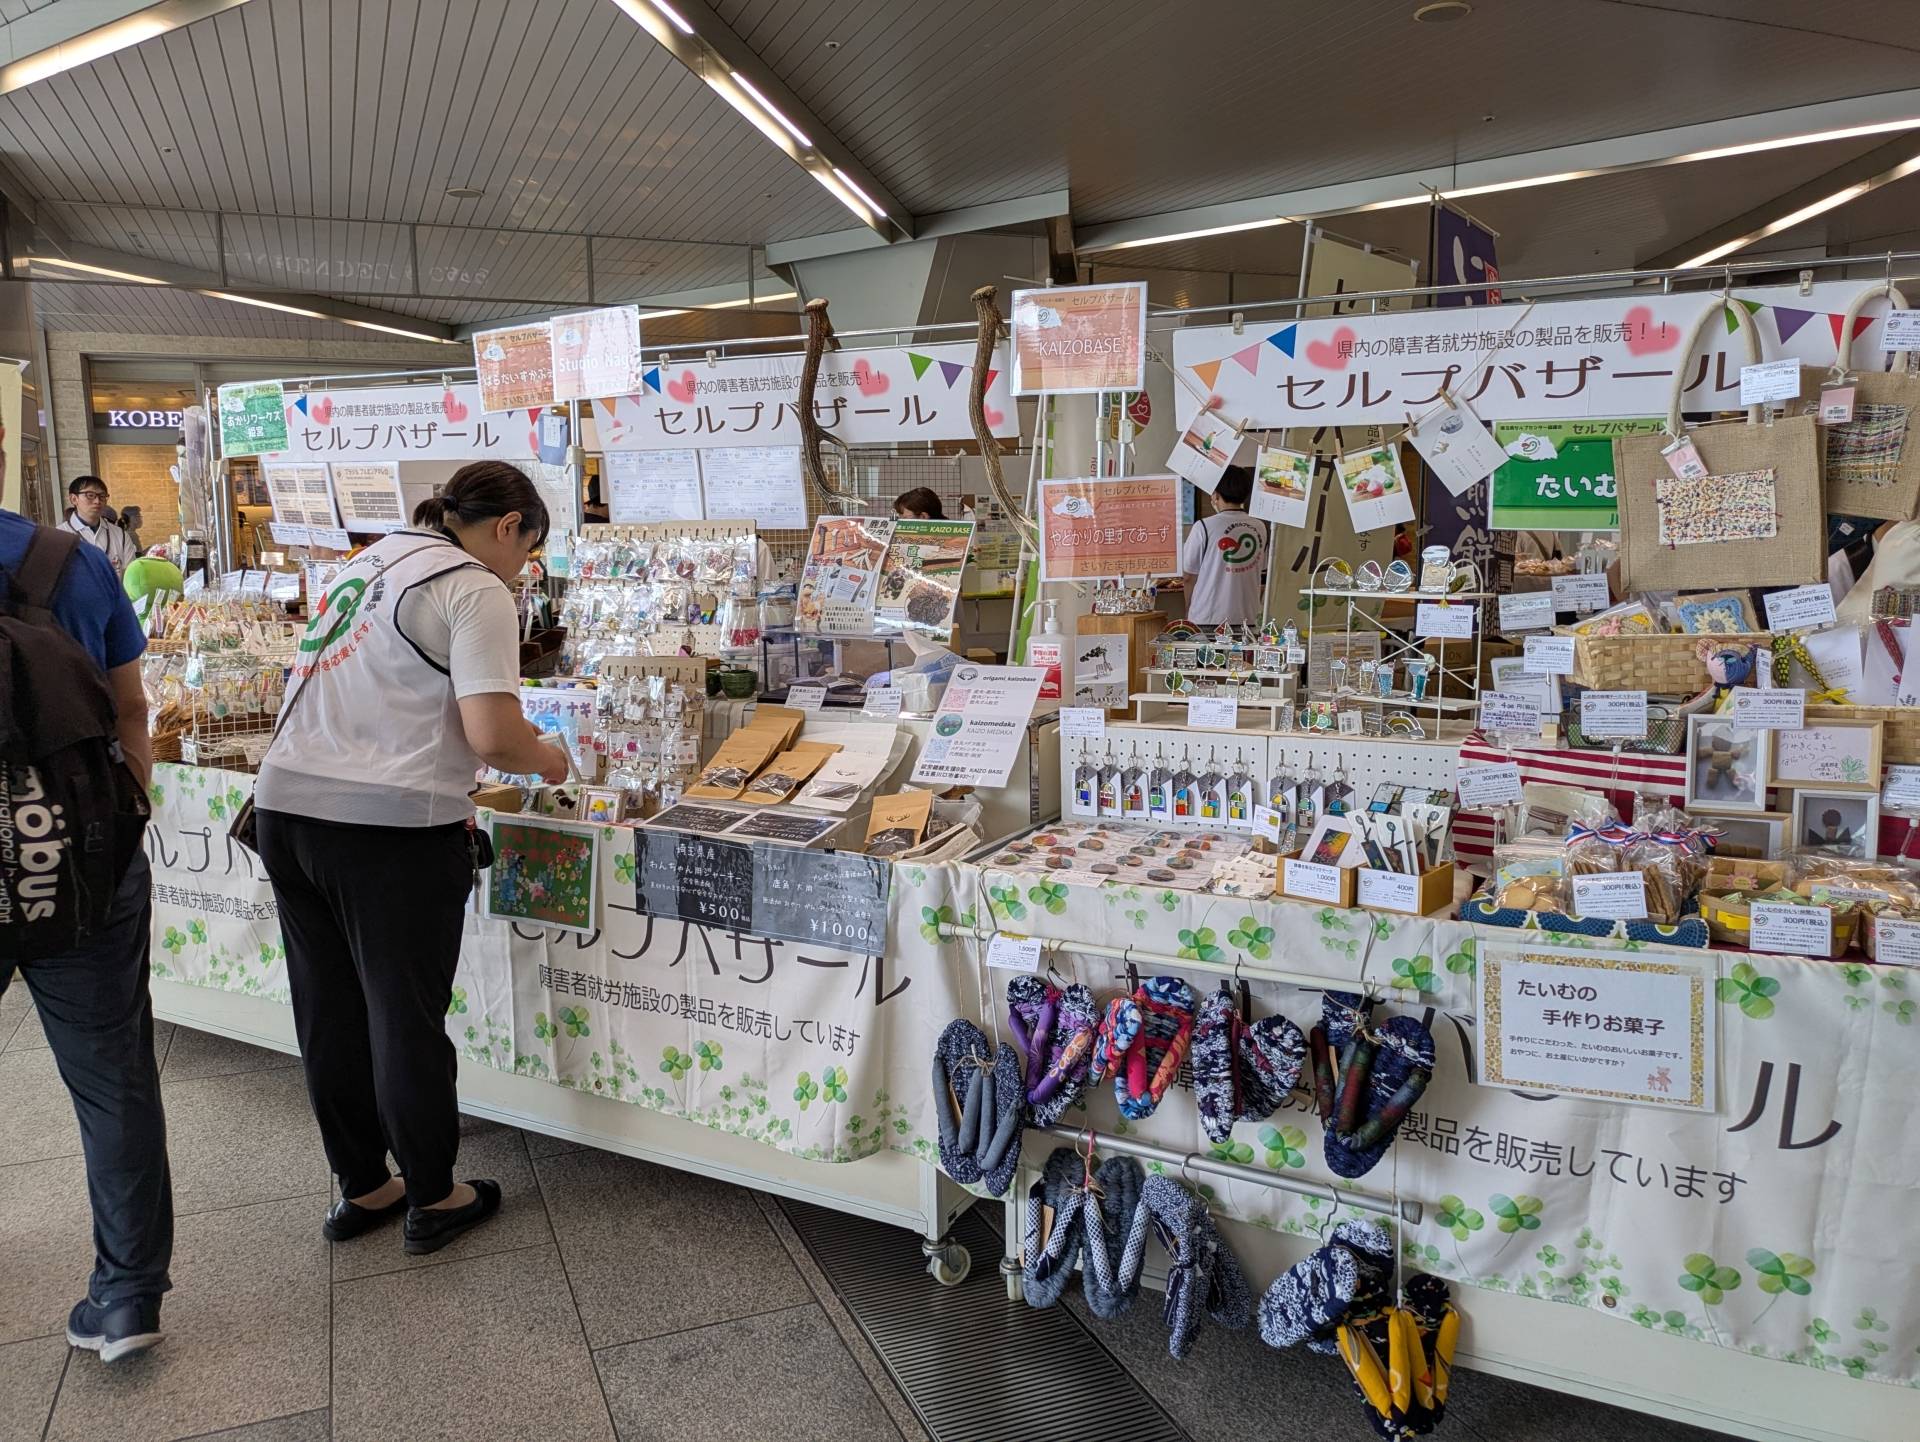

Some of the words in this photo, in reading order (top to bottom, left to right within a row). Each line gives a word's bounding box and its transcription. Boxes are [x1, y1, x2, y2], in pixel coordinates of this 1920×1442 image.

[1039, 337, 1121, 357] KAIZOBASE
[559, 355, 599, 373] Studio
[301, 421, 500, 451] セルプバザール
[1535, 473, 1617, 499] たいむ
[929, 525, 952, 534] KAIZO
[953, 526, 972, 534] BASE
[1050, 524, 1171, 547] やどかりの里すてあーず
[1080, 558, 1171, 572] さいたま市見沼区
[699, 900, 739, 921] ¥500
[1782, 916, 1828, 927] 300円(税込)
[808, 918, 869, 941] ¥1000
[1517, 978, 1598, 1002] たいむの
[537, 962, 862, 1058] 障害者就労施設の製品を販売しています
[1542, 1008, 1666, 1036] 手作りお菓子
[1508, 1034, 1684, 1061] 手作りにこだわった、たいむのおいしいお菓子です。
